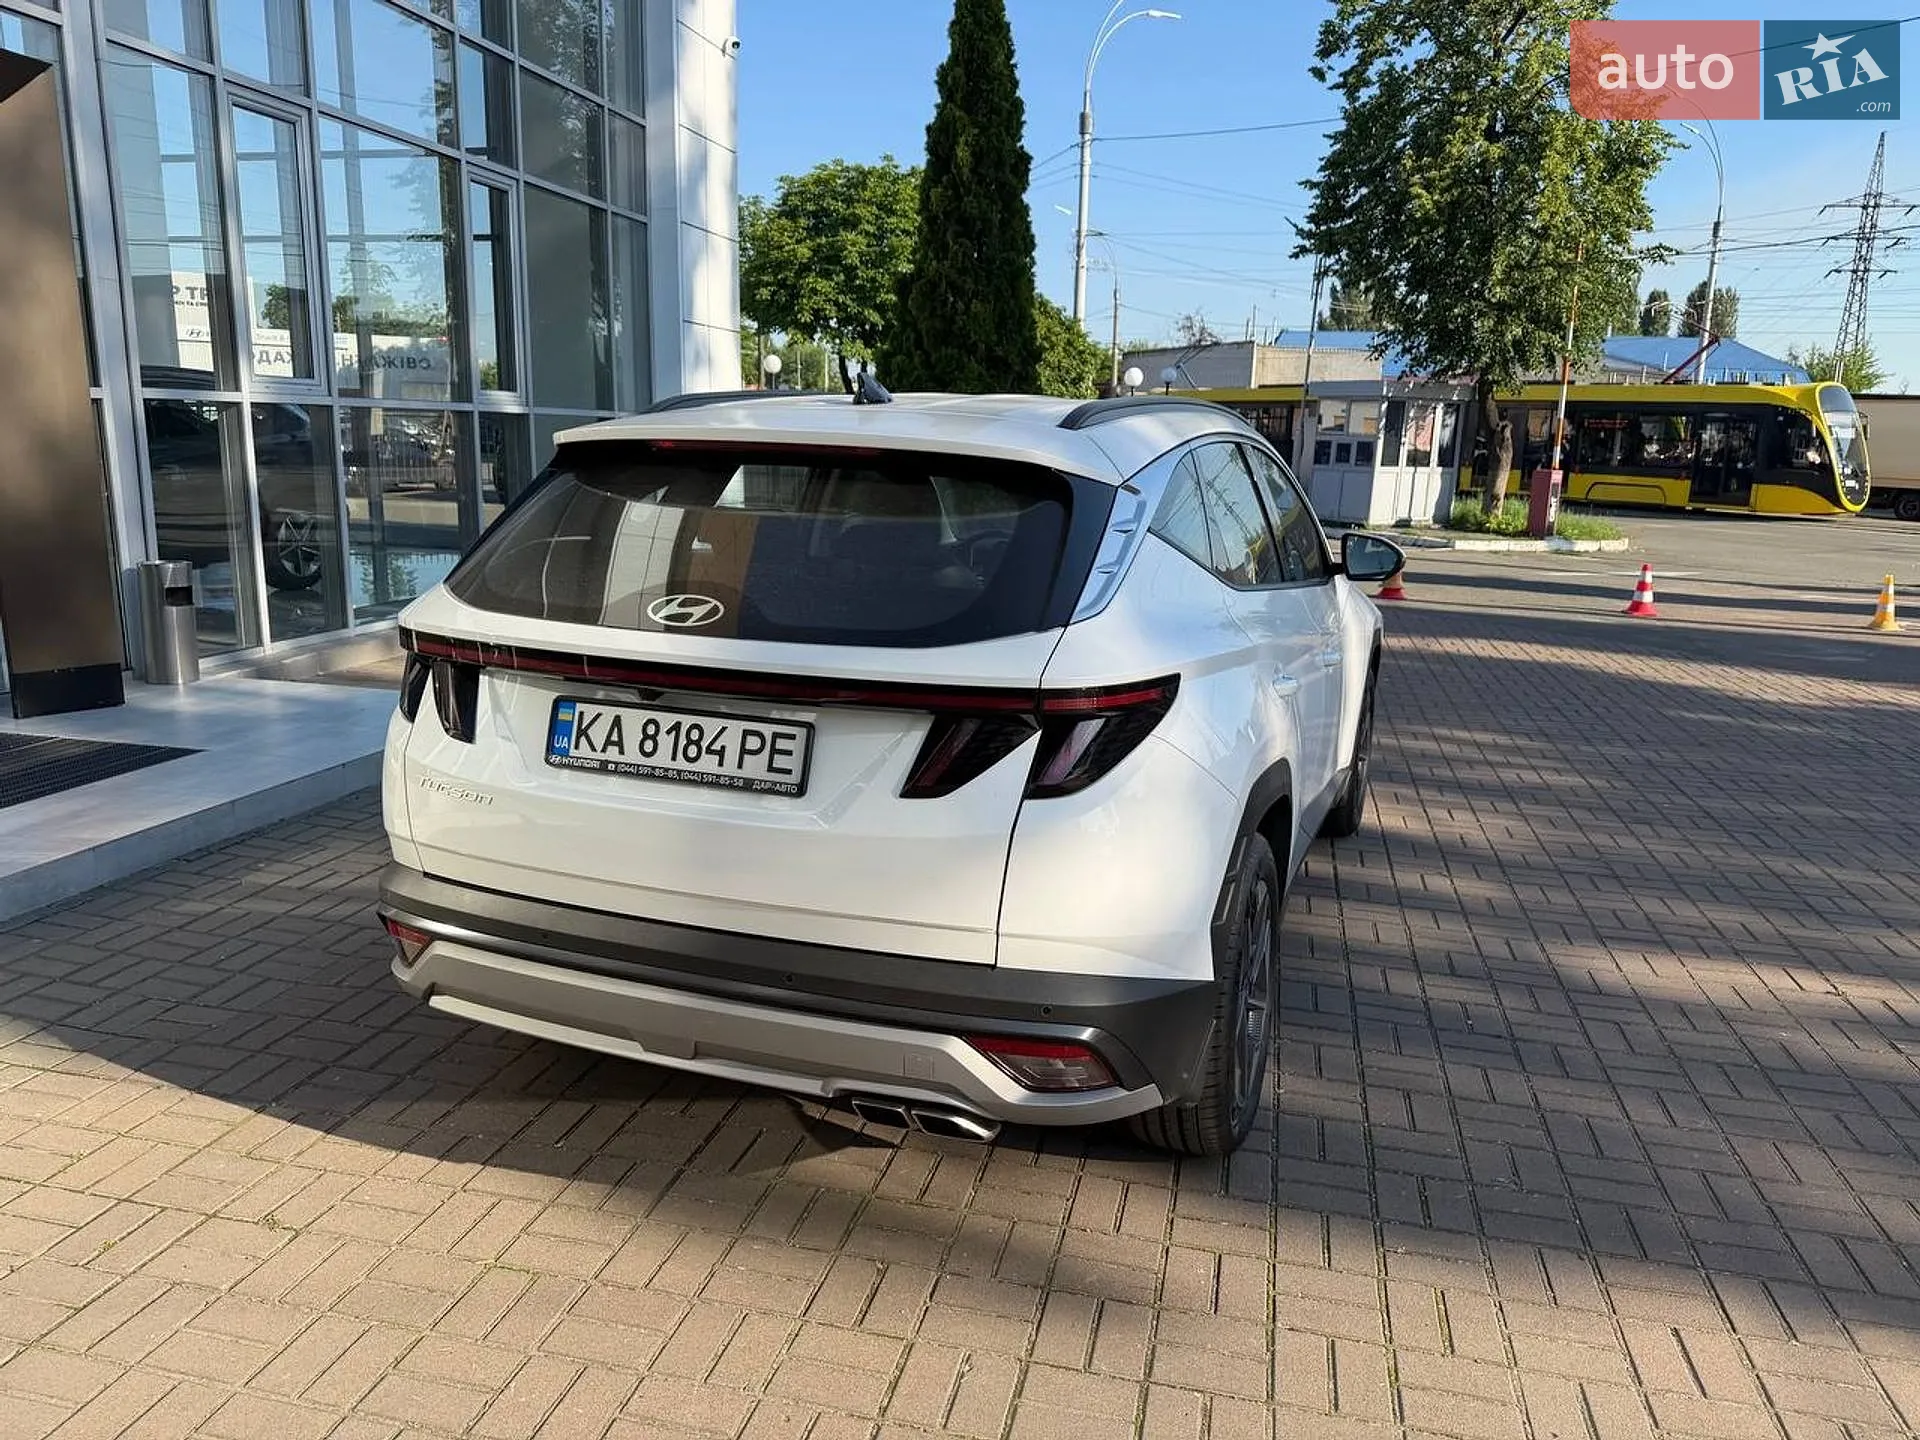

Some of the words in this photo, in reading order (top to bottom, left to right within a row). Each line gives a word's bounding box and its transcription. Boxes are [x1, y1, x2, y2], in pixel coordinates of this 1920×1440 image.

[553, 735, 570, 749] UA
[574, 710, 625, 756] KA
[638, 718, 728, 768] 8184
[736, 728, 796, 775] PE
[562, 756, 601, 768] HYUNDAI
[617, 763, 637, 774] (044)
